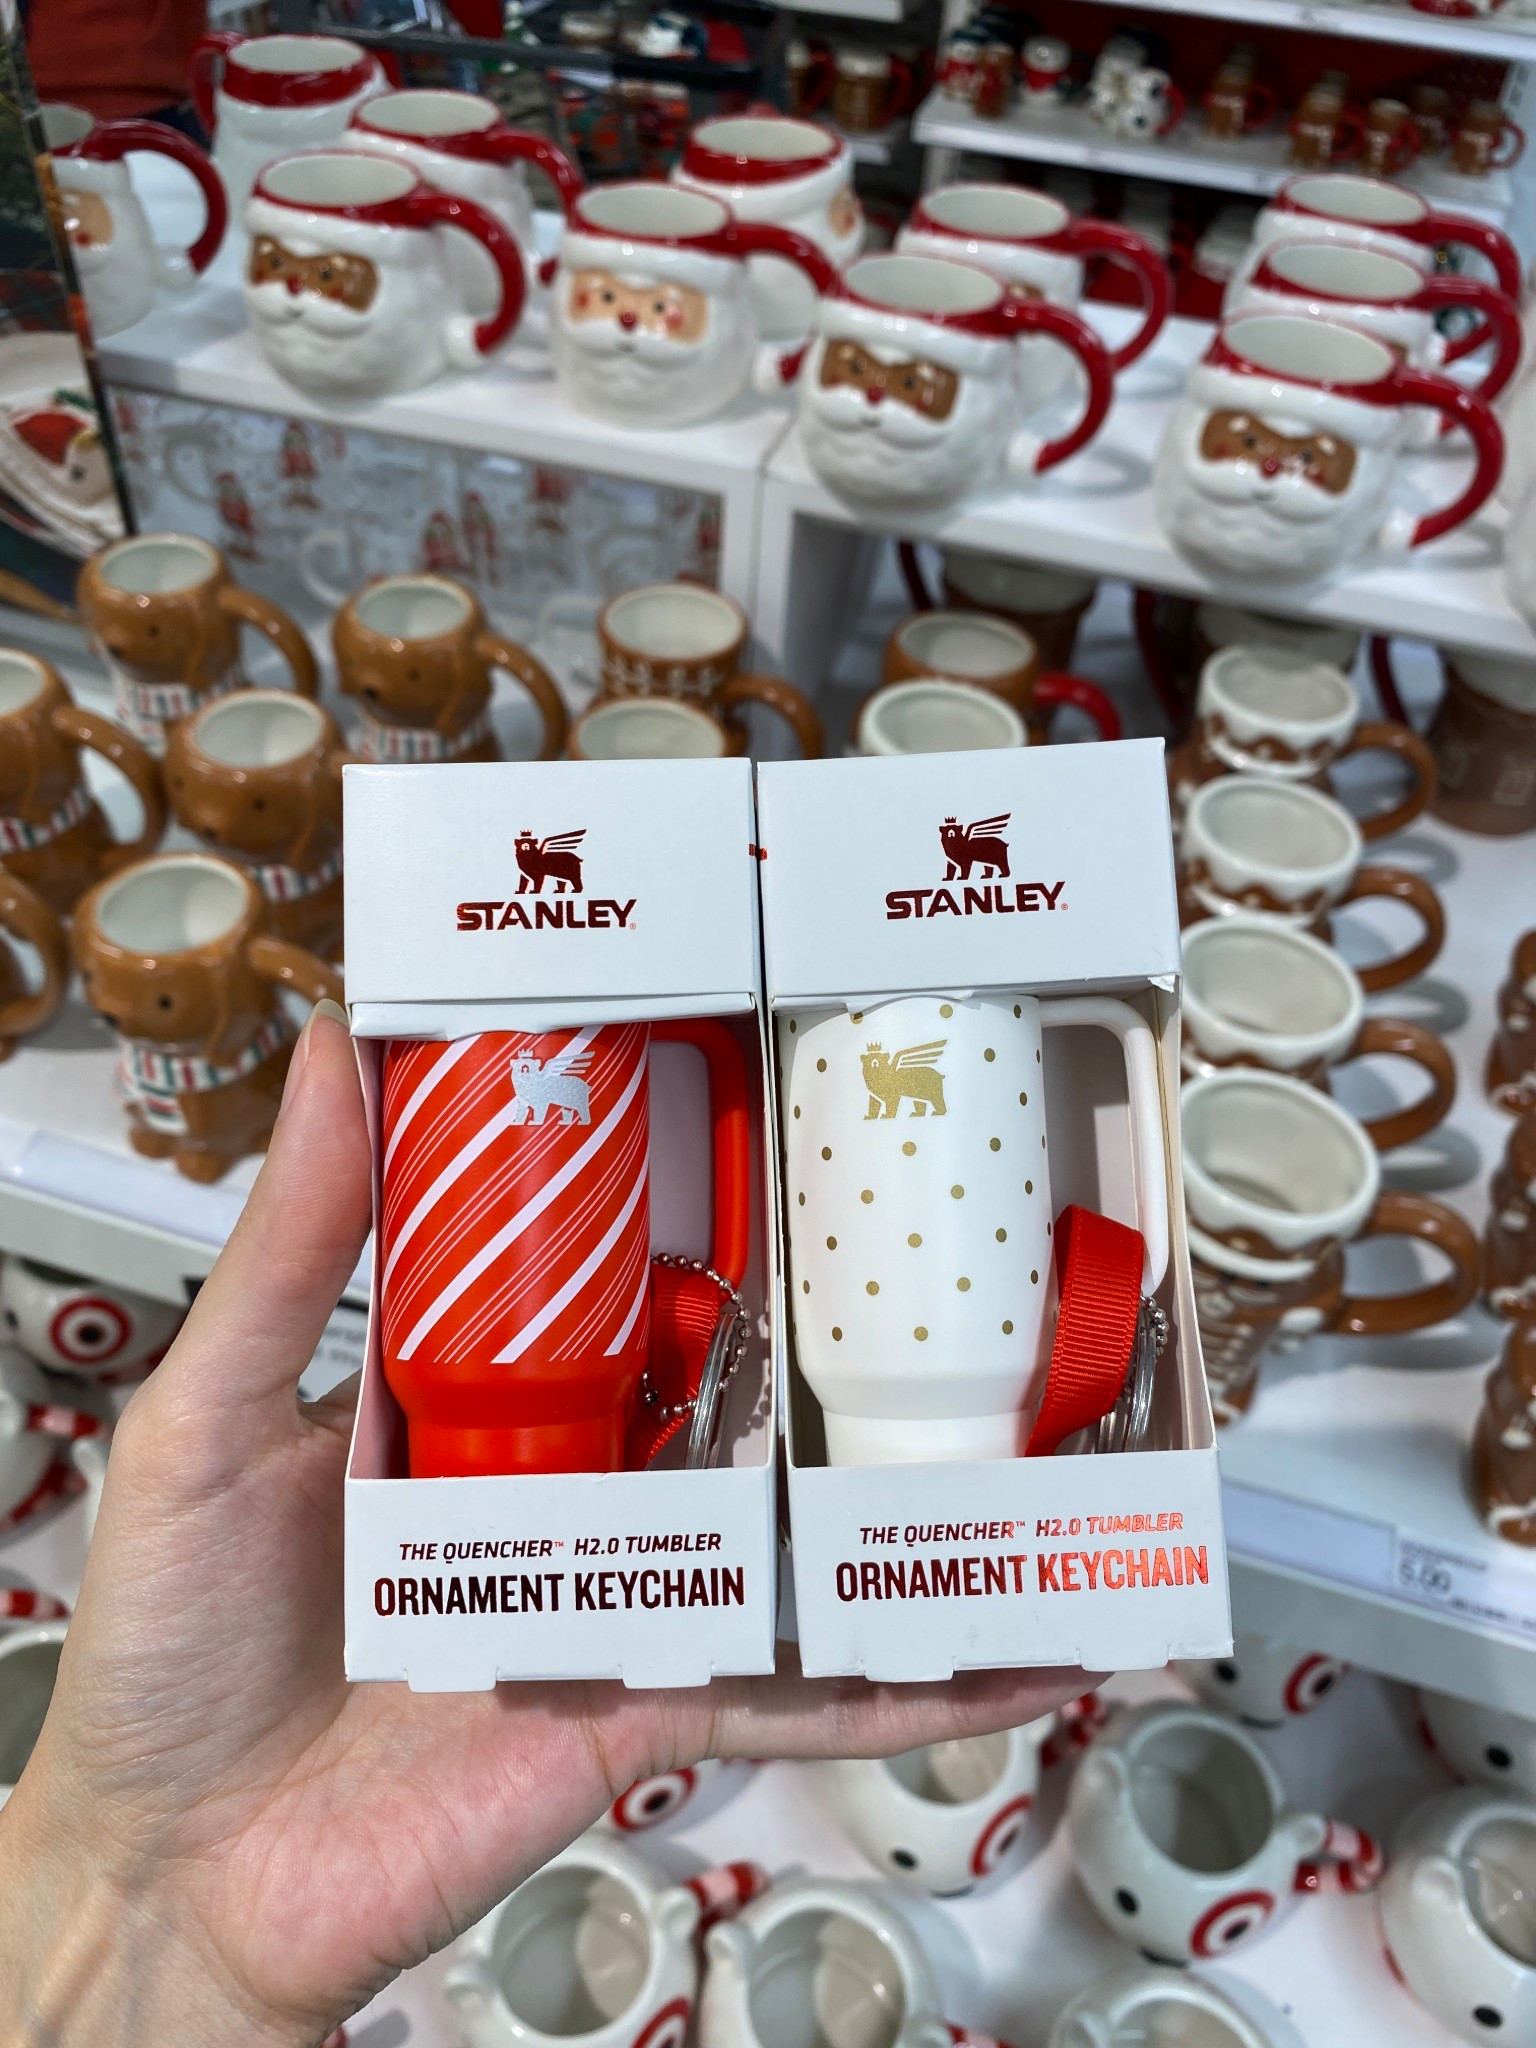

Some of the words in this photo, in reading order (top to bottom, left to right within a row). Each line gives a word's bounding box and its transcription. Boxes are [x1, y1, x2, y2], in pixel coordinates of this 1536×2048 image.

[399, 1543, 437, 1561] THE
[574, 1537, 620, 1556] H2.0
[625, 1533, 721, 1554] TUMBLER
[860, 1527, 898, 1545] THE
[1035, 1517, 1081, 1538] H2.0
[1086, 1512, 1184, 1536] TUMBLER
[374, 1573, 565, 1616] ORNAMENT
[574, 1566, 745, 1611] KEYCHAIN
[835, 1554, 1028, 1602] ORNAMENT
[1037, 1545, 1210, 1594] KEYCHAIN
